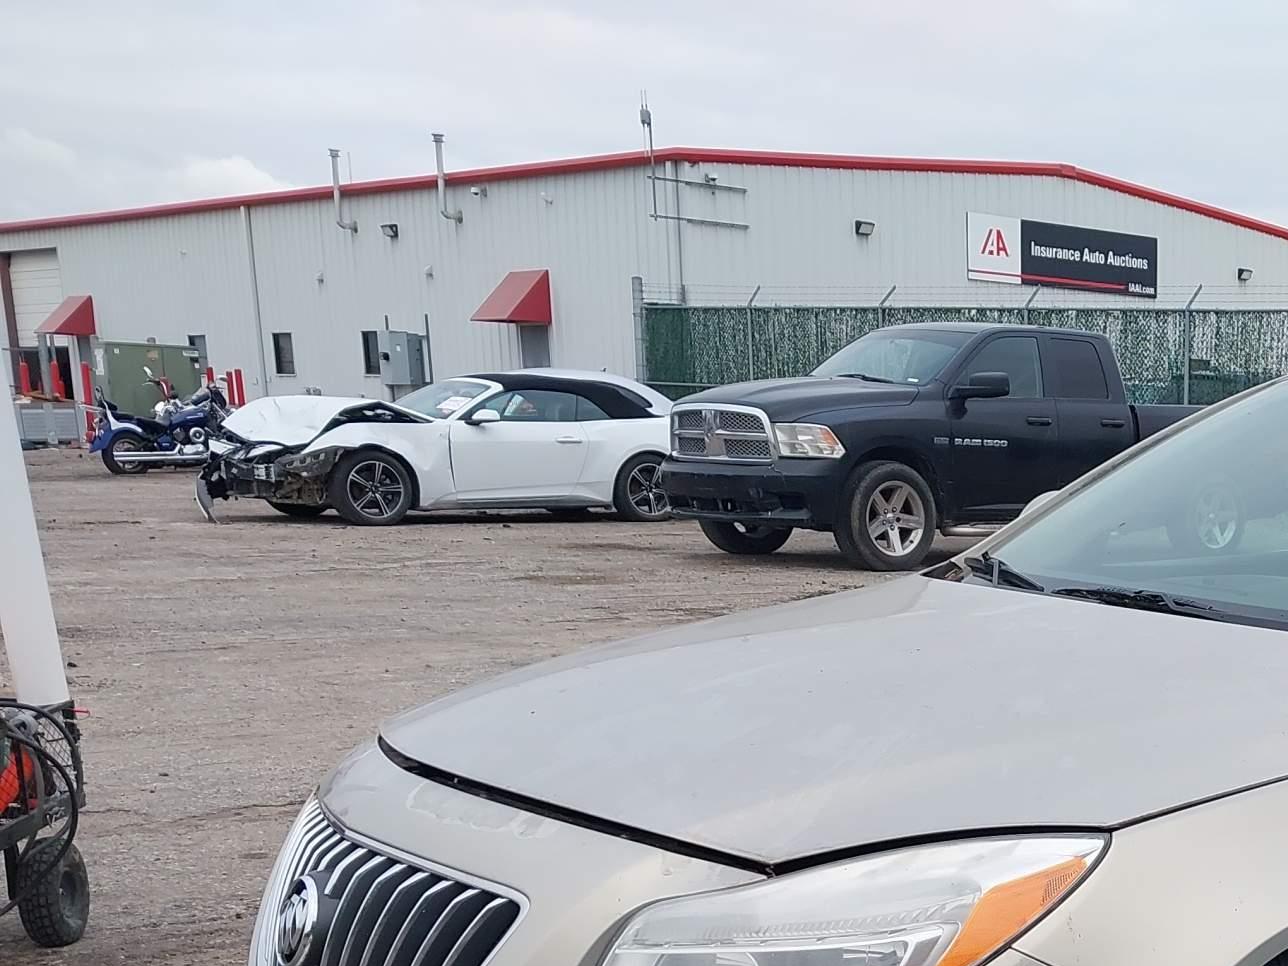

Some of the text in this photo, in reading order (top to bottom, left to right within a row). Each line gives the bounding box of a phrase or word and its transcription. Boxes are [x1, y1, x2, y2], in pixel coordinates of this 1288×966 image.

[1031, 241, 1149, 270] Insurance Auto Auctions
[954, 438, 982, 446] RAM
